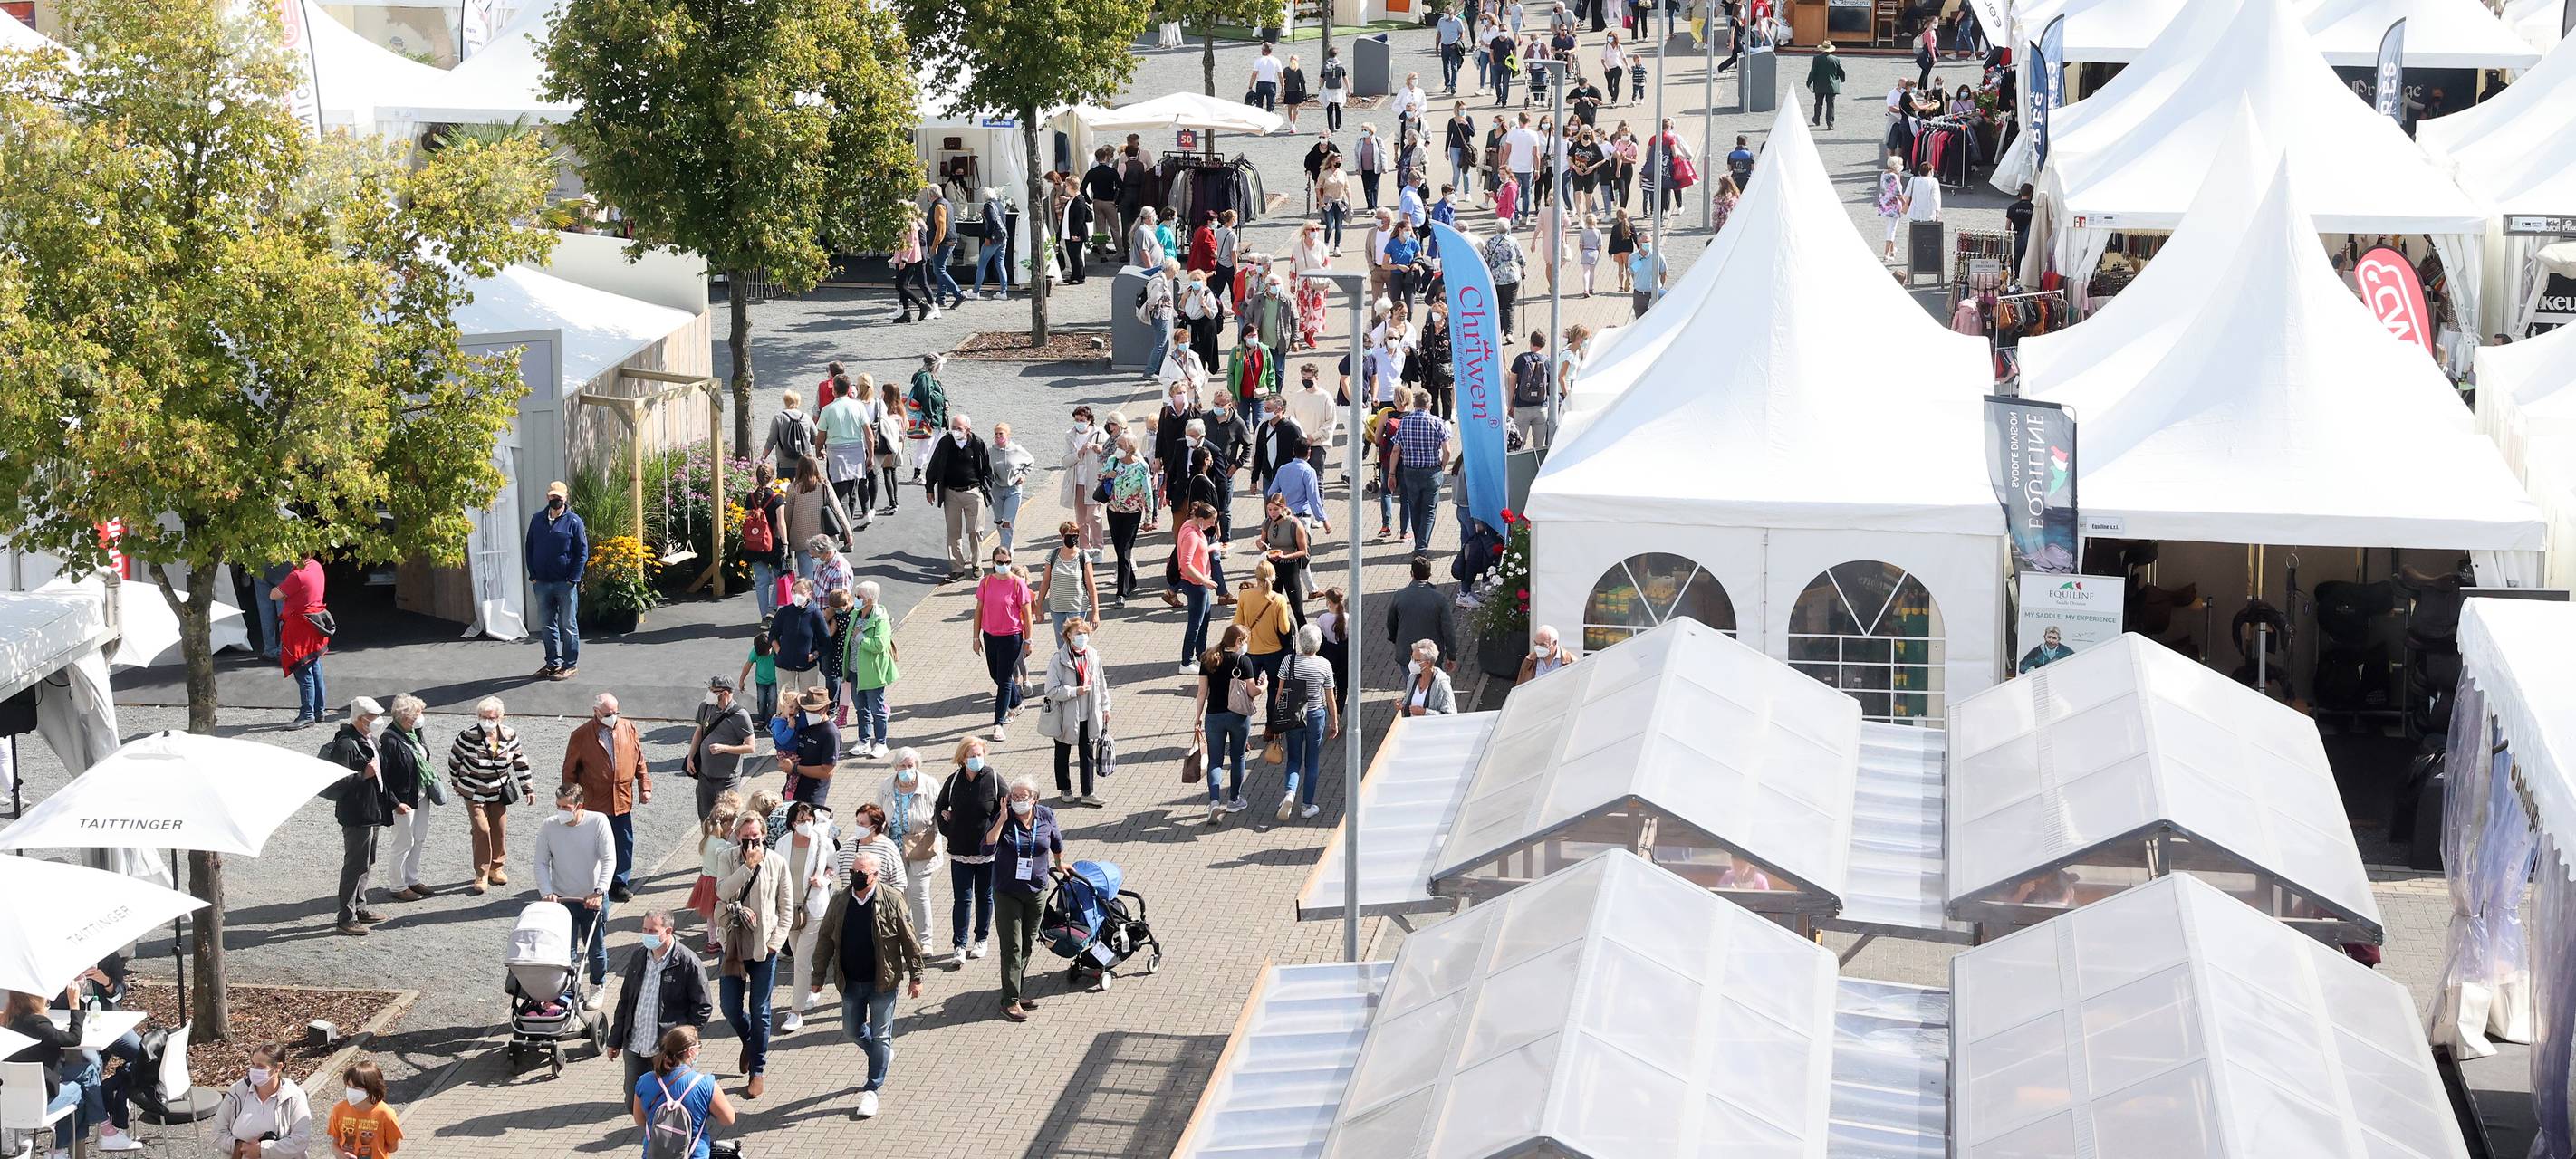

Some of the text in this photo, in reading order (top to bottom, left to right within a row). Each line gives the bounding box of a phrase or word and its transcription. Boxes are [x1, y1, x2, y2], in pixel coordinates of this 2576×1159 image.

[1180, 135, 1193, 144] 50
[1458, 286, 1487, 420] Chriwen
[2049, 589, 2094, 600] EQUILINE
[2076, 615, 2117, 623] EXPERIENCE
[79, 818, 183, 830] TAITTINGER
[66, 905, 133, 945] TAITTINGER
